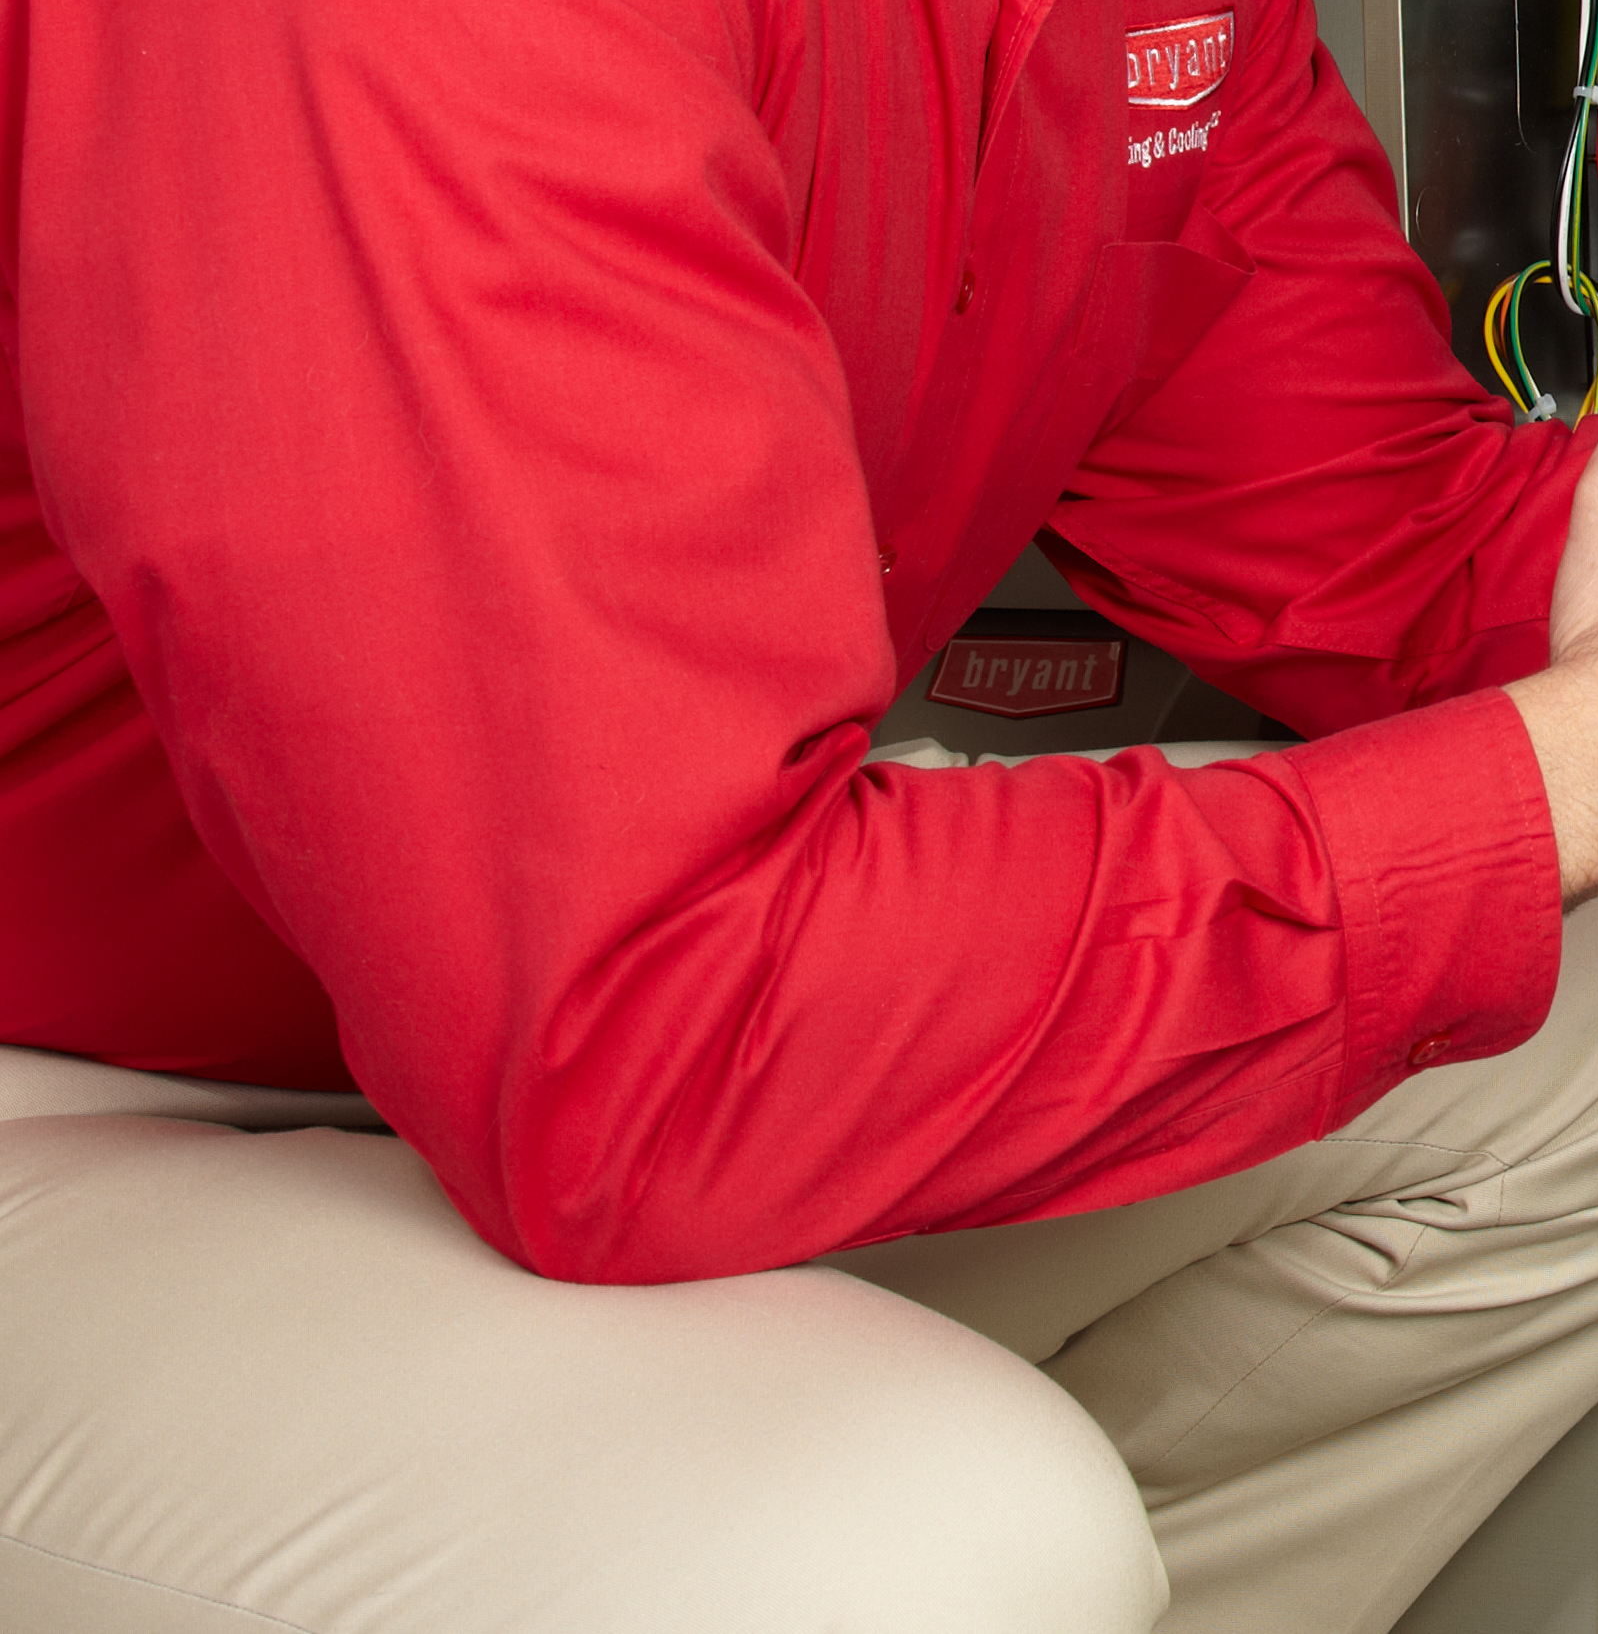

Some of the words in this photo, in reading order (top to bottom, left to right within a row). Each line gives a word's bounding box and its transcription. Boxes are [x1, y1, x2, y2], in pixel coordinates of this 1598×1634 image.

[1153, 131, 1165, 159] &
[1168, 121, 1209, 155] Cooling
[962, 650, 1098, 696] bryant
